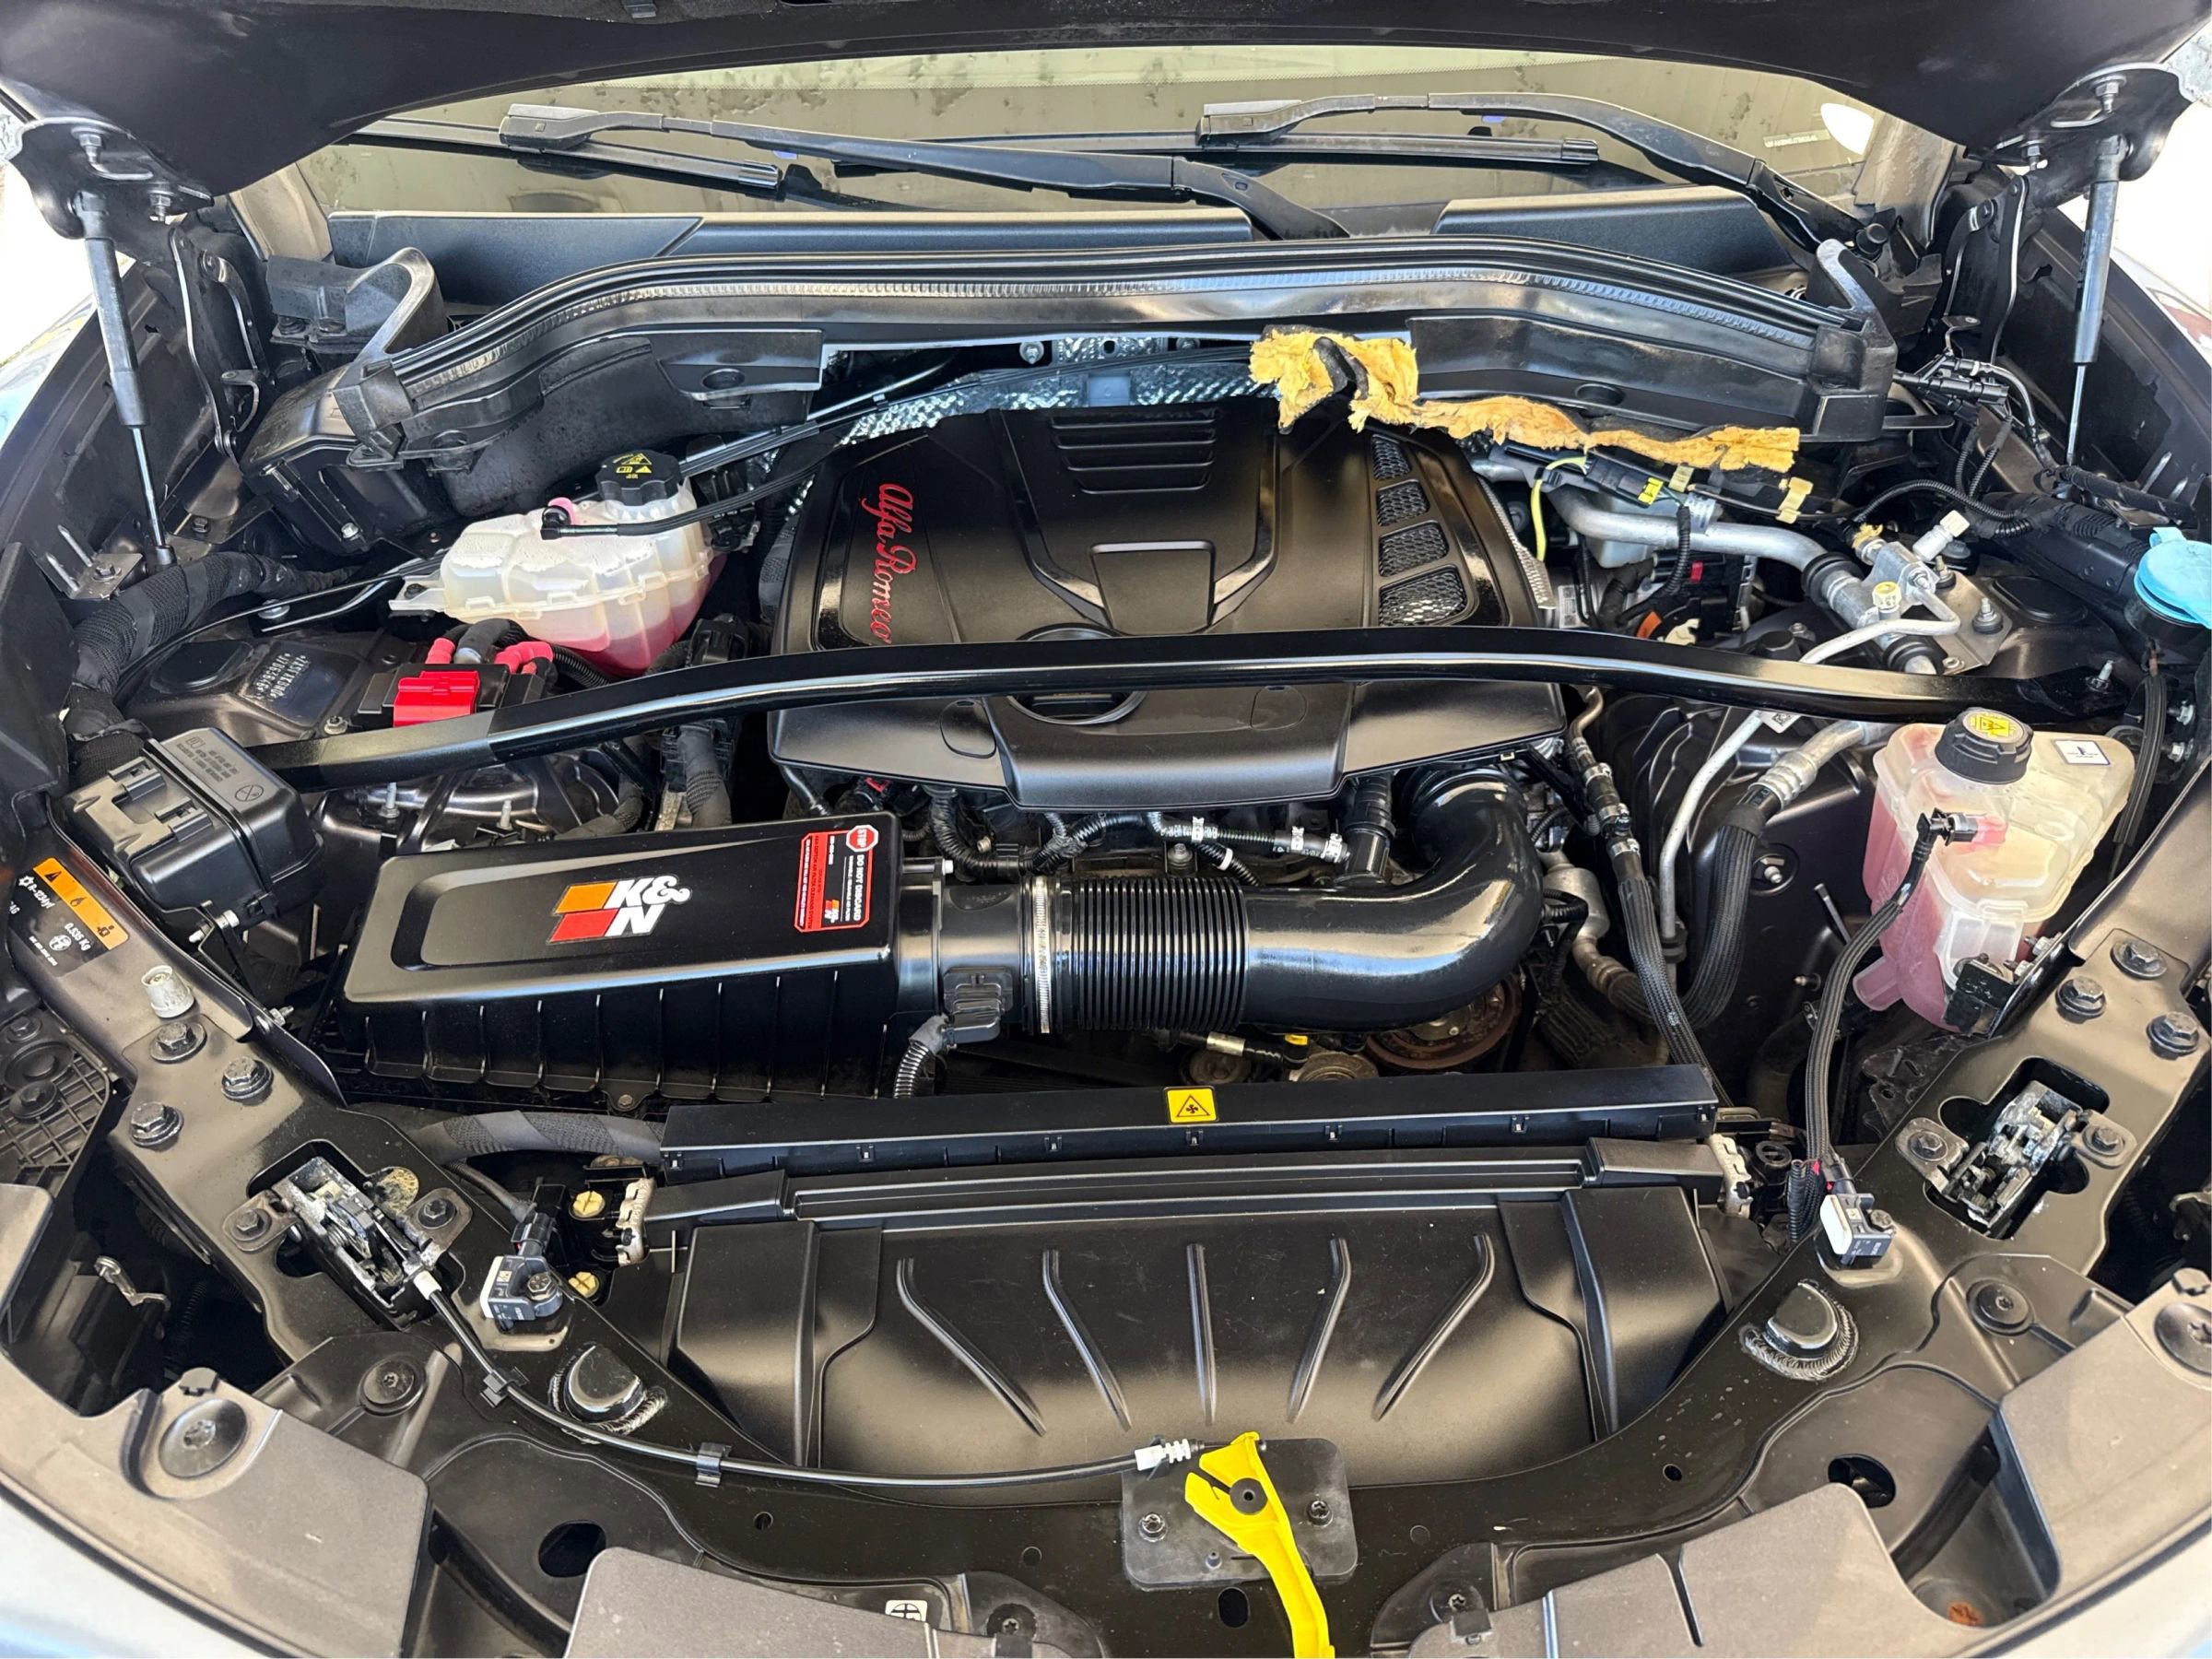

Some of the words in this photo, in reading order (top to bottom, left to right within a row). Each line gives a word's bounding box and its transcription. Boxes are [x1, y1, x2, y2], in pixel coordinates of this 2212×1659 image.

[859, 483, 913, 543] Alfa
[871, 544, 917, 643] Romeo
[857, 829, 867, 848] STOP
[857, 854, 865, 866] DO
[855, 867, 864, 883] NOT
[853, 885, 863, 921] DISCARD
